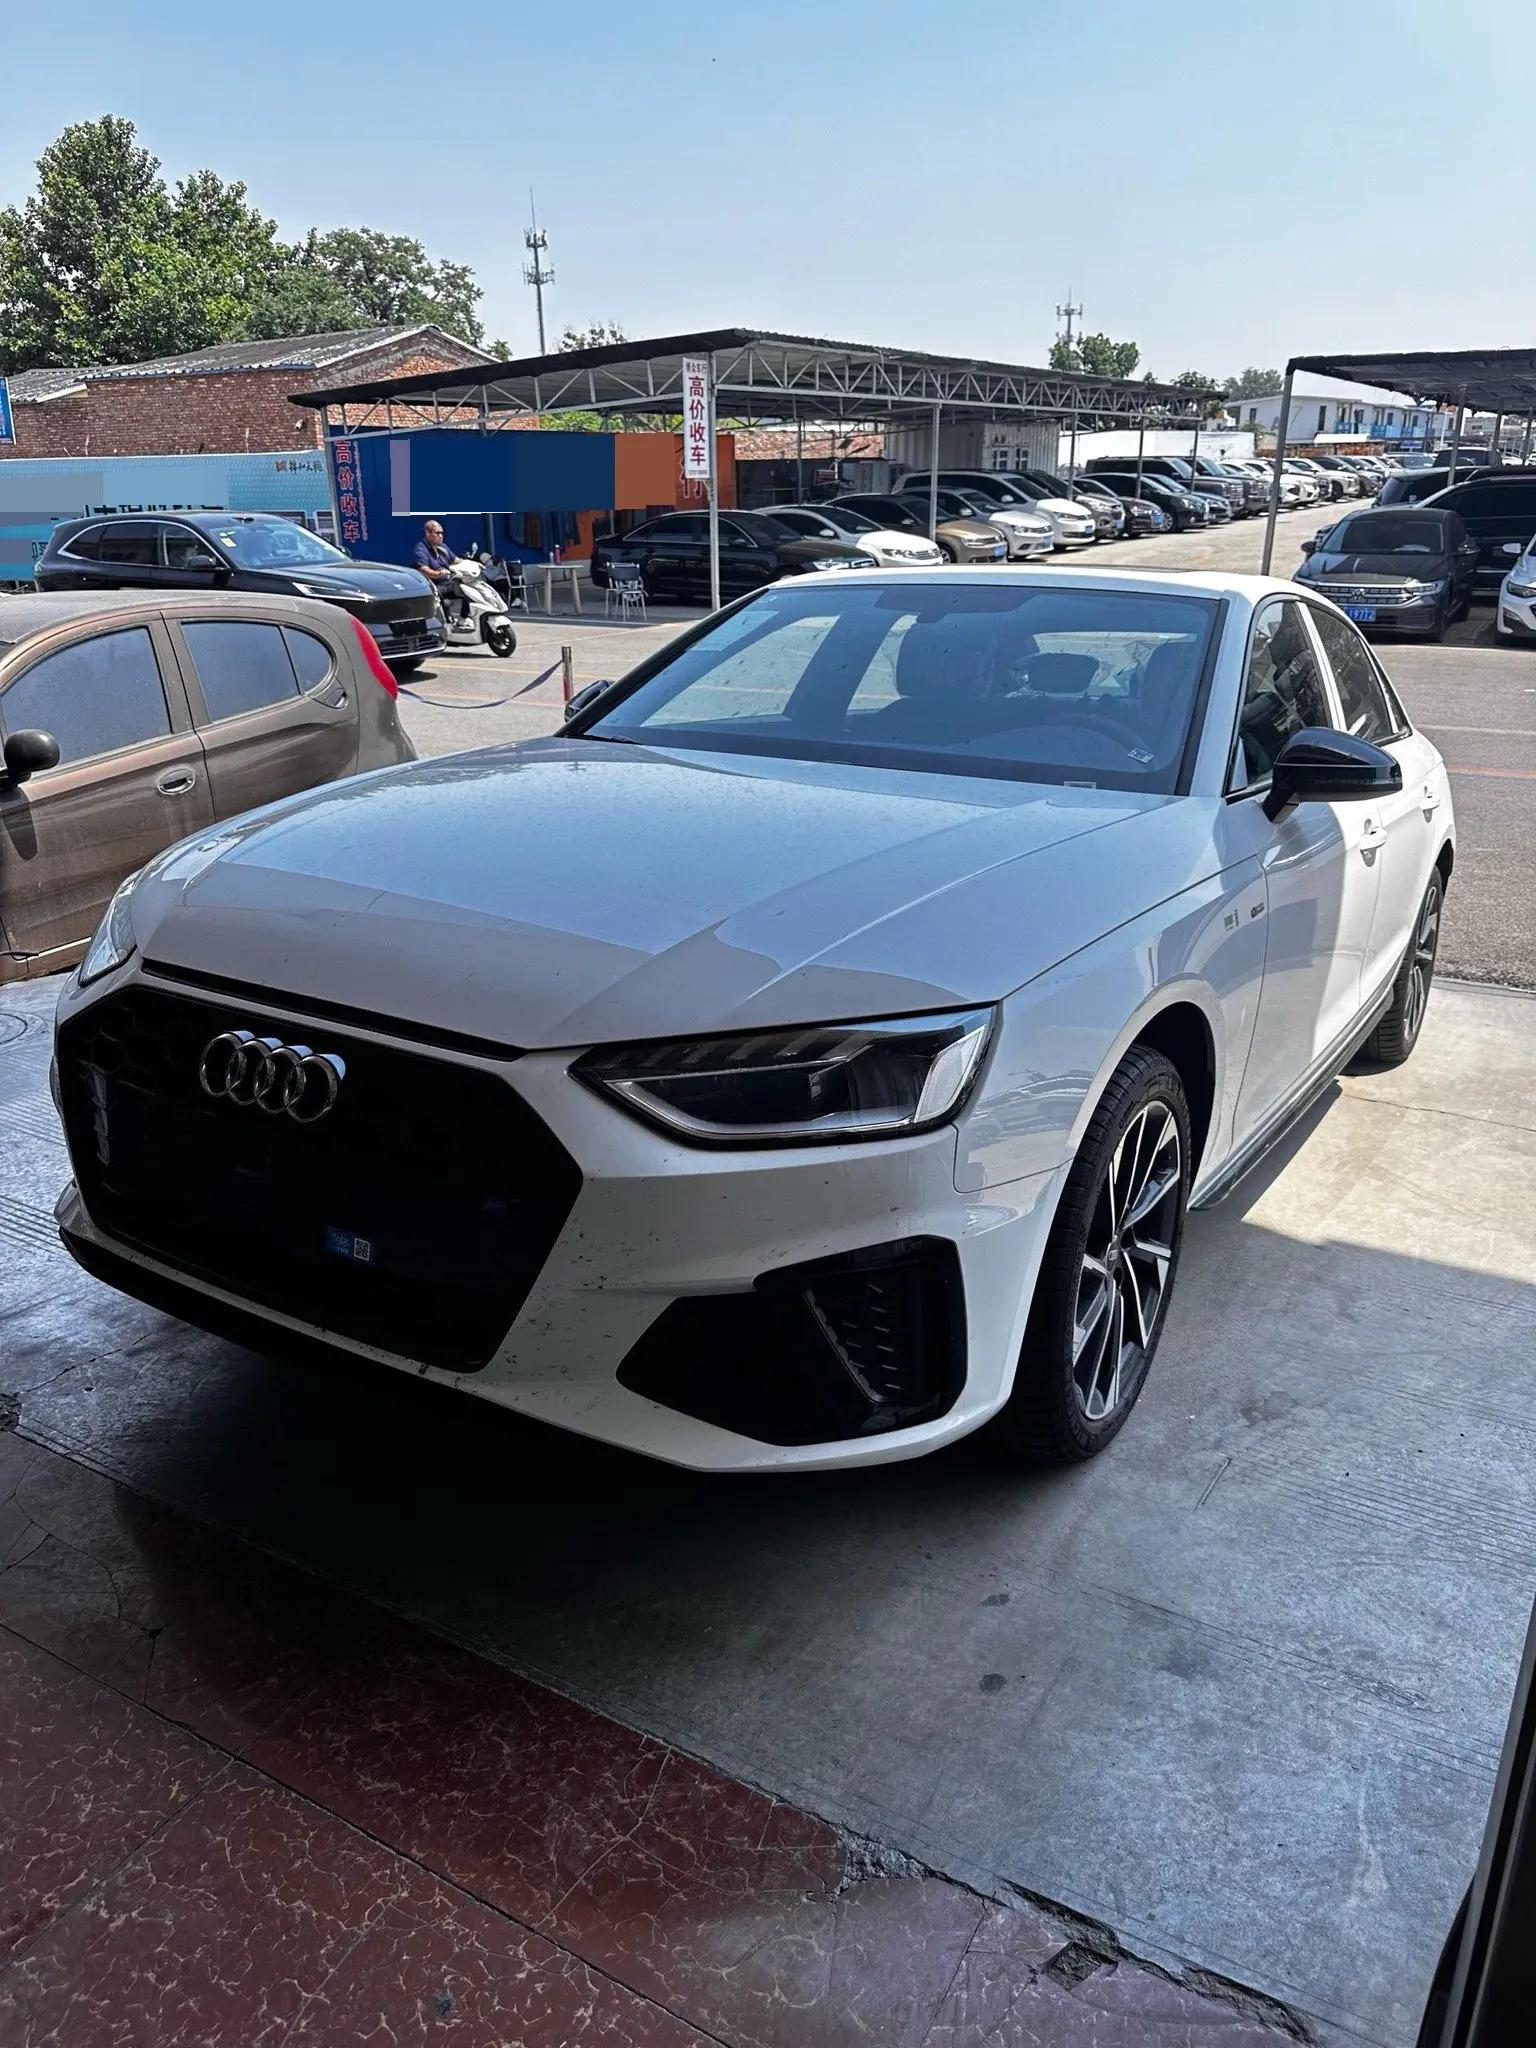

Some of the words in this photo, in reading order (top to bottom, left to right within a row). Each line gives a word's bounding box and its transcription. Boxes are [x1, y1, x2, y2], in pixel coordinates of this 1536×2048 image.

[688, 375, 706, 466] 高价收车
[334, 439, 360, 543] 高价收车
